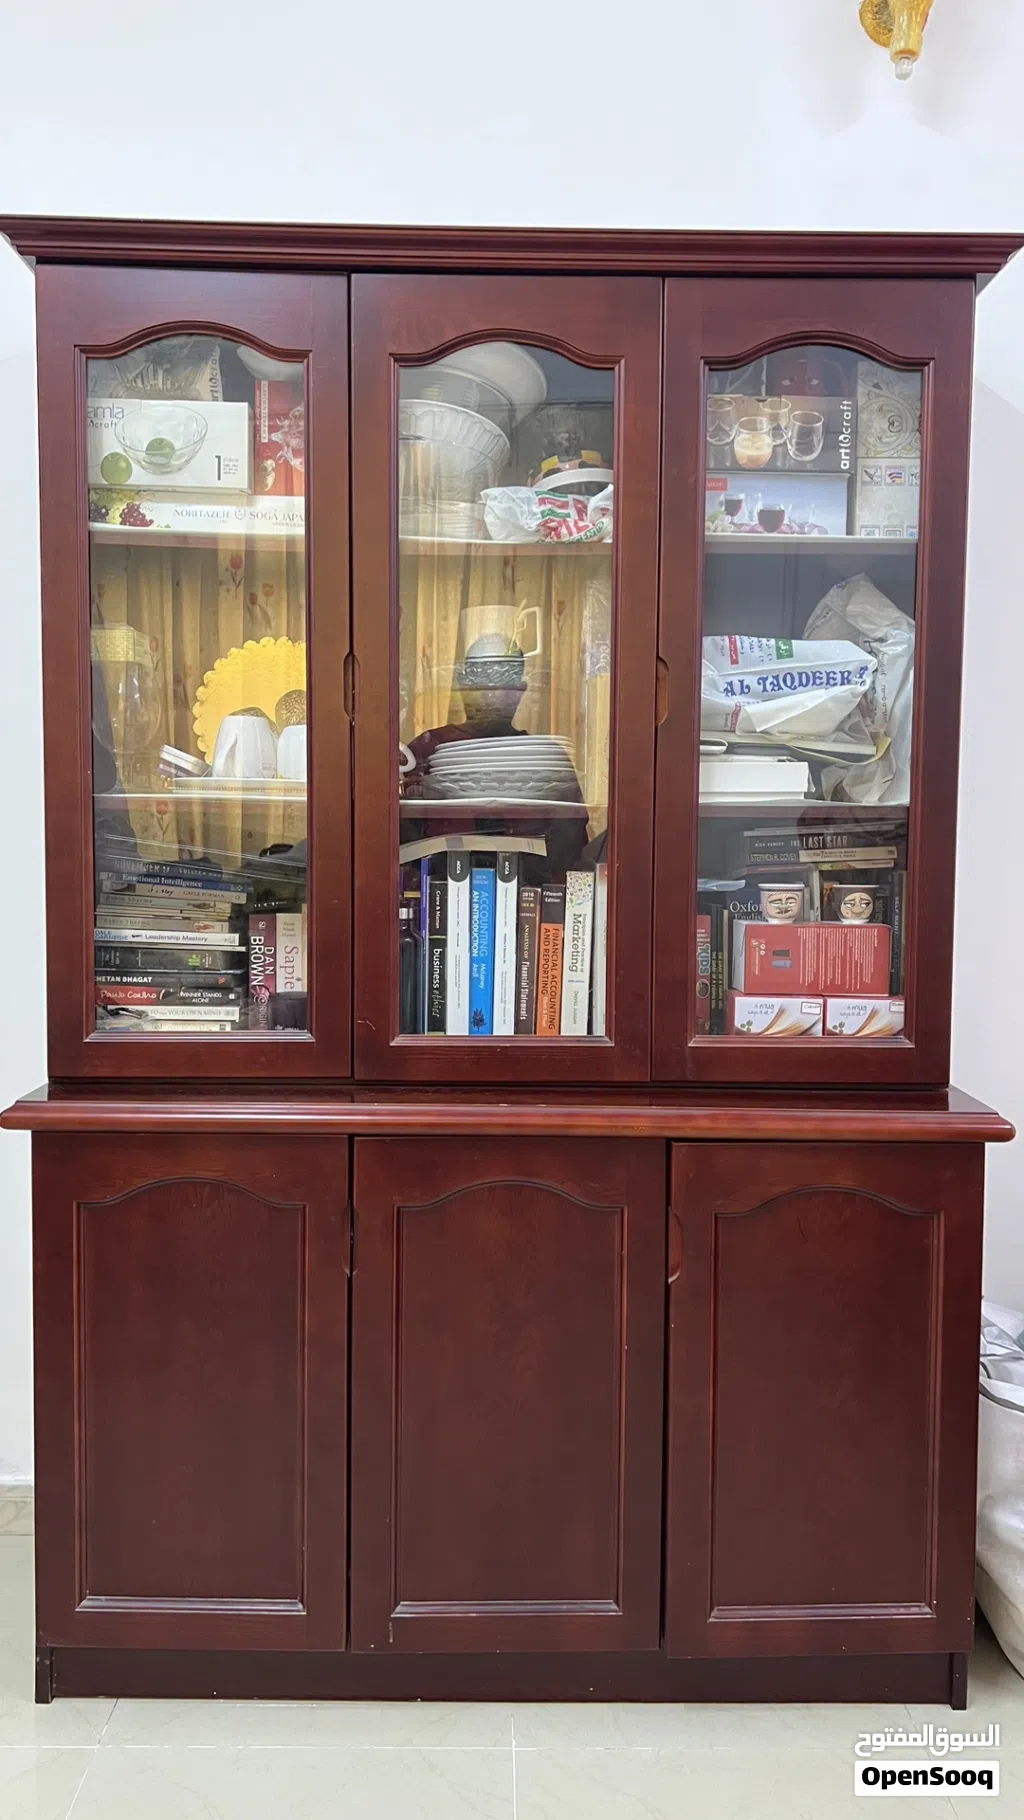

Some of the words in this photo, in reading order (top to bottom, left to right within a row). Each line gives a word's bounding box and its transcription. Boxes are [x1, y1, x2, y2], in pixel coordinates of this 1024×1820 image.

[215, 455, 221, 481] 1
[723, 678, 751, 698] AL
[757, 670, 852, 692] TAQDEER
[803, 836, 824, 849] LAST
[826, 835, 848, 848] STAR
[122, 874, 160, 884] Emotional
[161, 878, 203, 888] Intelligence
[471, 890, 479, 902] AN
[471, 903, 479, 957] INTRODUCTION
[479, 891, 489, 957] ACCOUNTING
[543, 928, 551, 945] AND
[551, 928, 560, 970] FINANCIAL
[569, 913, 582, 972] Marketing
[250, 936, 265, 986] BROWN
[264, 947, 275, 975] DAN
[431, 948, 442, 988] business
[541, 946, 550, 995] REPORTING
[100, 990, 125, 998] Paulo
[127, 990, 157, 999] Coelho
[431, 989, 444, 1017] ethics
[548, 971, 558, 1030] ACCOUNTING
